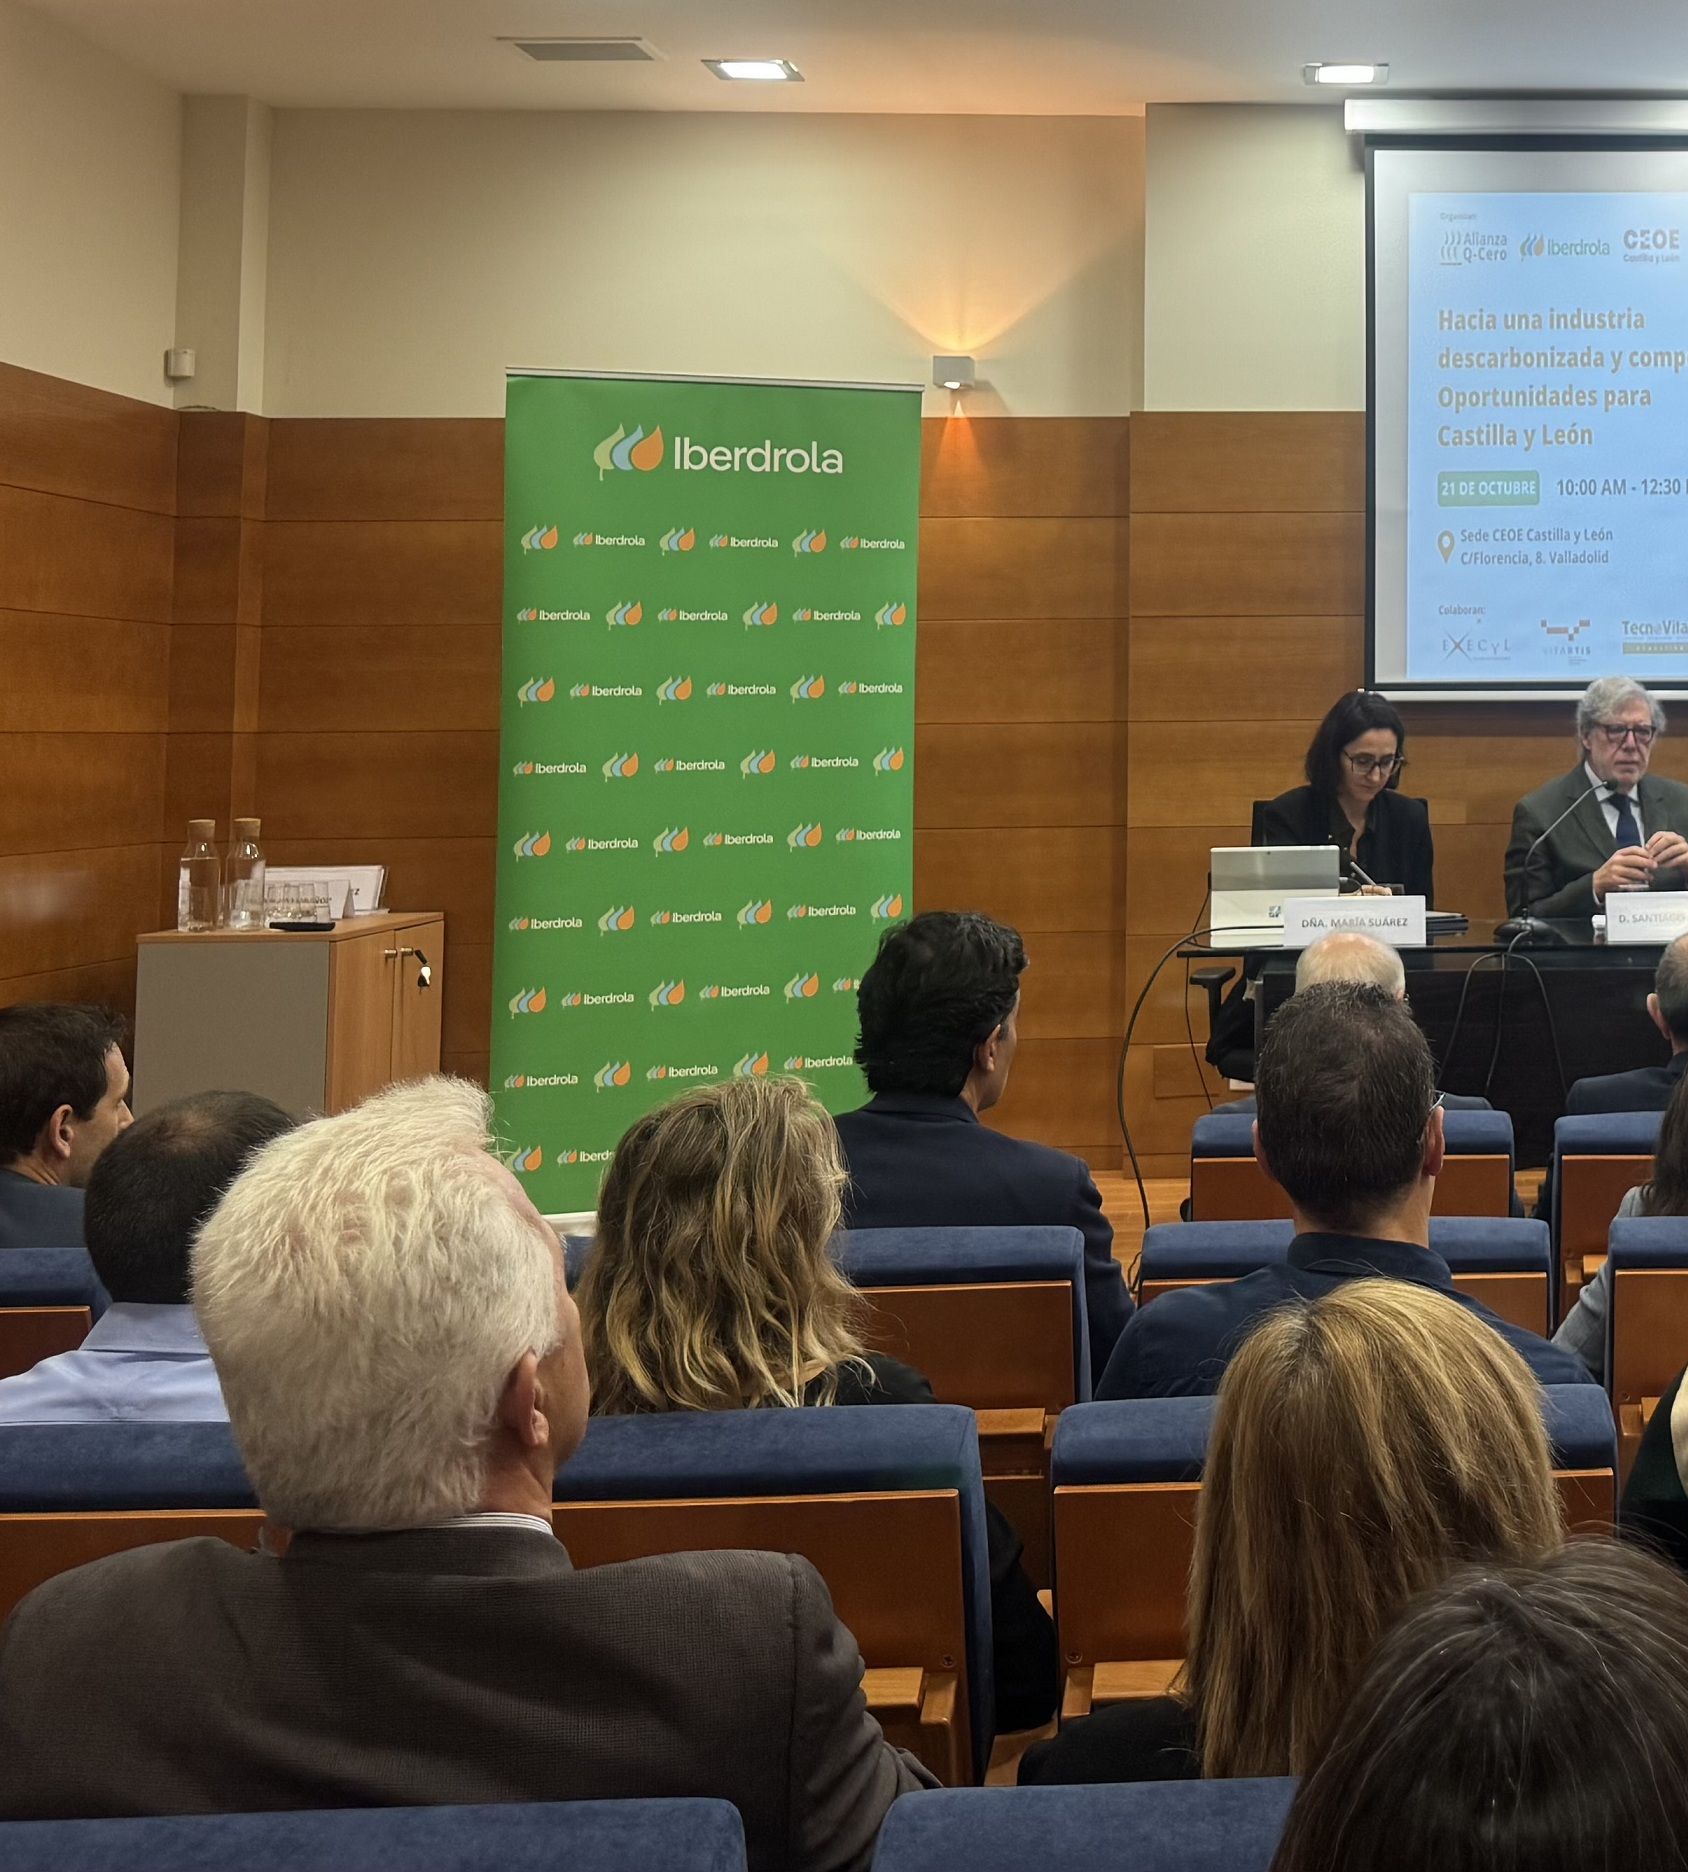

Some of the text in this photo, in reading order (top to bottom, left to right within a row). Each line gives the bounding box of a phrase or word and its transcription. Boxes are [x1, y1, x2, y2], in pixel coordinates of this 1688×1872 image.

[1464, 232, 1508, 246] Alianza
[1623, 229, 1679, 249] CEOE
[1548, 239, 1610, 255] Iberdrola
[1463, 247, 1508, 263] Q-Cero
[1439, 308, 1645, 330] Hacia una industria
[1438, 347, 1604, 368] descarbonizada
[1610, 351, 1623, 373] y
[1438, 385, 1651, 413] Oportunidades para
[1438, 423, 1592, 451] Castilla y León
[674, 437, 843, 473] Iberdrola
[1441, 481, 1536, 495] 21 DE OCTUBRE
[1558, 480, 1597, 495] 10:00
[1600, 480, 1626, 494] AM
[1642, 479, 1680, 494] 12:30
[595, 535, 645, 546] Iberdrola
[730, 536, 778, 548] Iberdrola
[1461, 528, 1613, 544] Sede CEOE Castilla y León
[860, 538, 905, 549] Iberdrola
[1461, 551, 1532, 566] C/Florencia,
[1550, 550, 1608, 564] Valladolid
[539, 609, 590, 621] Iberdrola
[679, 610, 728, 621] Iberdrola
[814, 609, 860, 621] Iberdrola
[1438, 605, 1486, 615] Colaboran:
[592, 685, 642, 696] Iberdrola
[728, 683, 776, 695] Iberdrola
[859, 682, 903, 694] Iberdrola
[535, 762, 586, 774] Iberdrola
[676, 759, 725, 771] Iberdrola
[811, 756, 858, 767] Iberdrola
[725, 832, 773, 845] Iberdrola
[856, 828, 900, 840] Iberdrola
[588, 837, 638, 850] Iberdrola
[672, 910, 721, 923] Iberdrola
[808, 904, 856, 916] Iberdrola
[531, 917, 582, 929] Iberdrola
[1302, 916, 1407, 928] DÑA. MARÍA SUÁREZ
[1619, 914, 1629, 923] D.
[721, 984, 770, 997] Iberdrola
[584, 991, 634, 1004] Iberdrola
[805, 1055, 852, 1068] Iberdrola
[668, 1064, 718, 1077] Iberdrola
[527, 1074, 578, 1087] Iberdrola
[580, 1150, 613, 1162] Iberd
